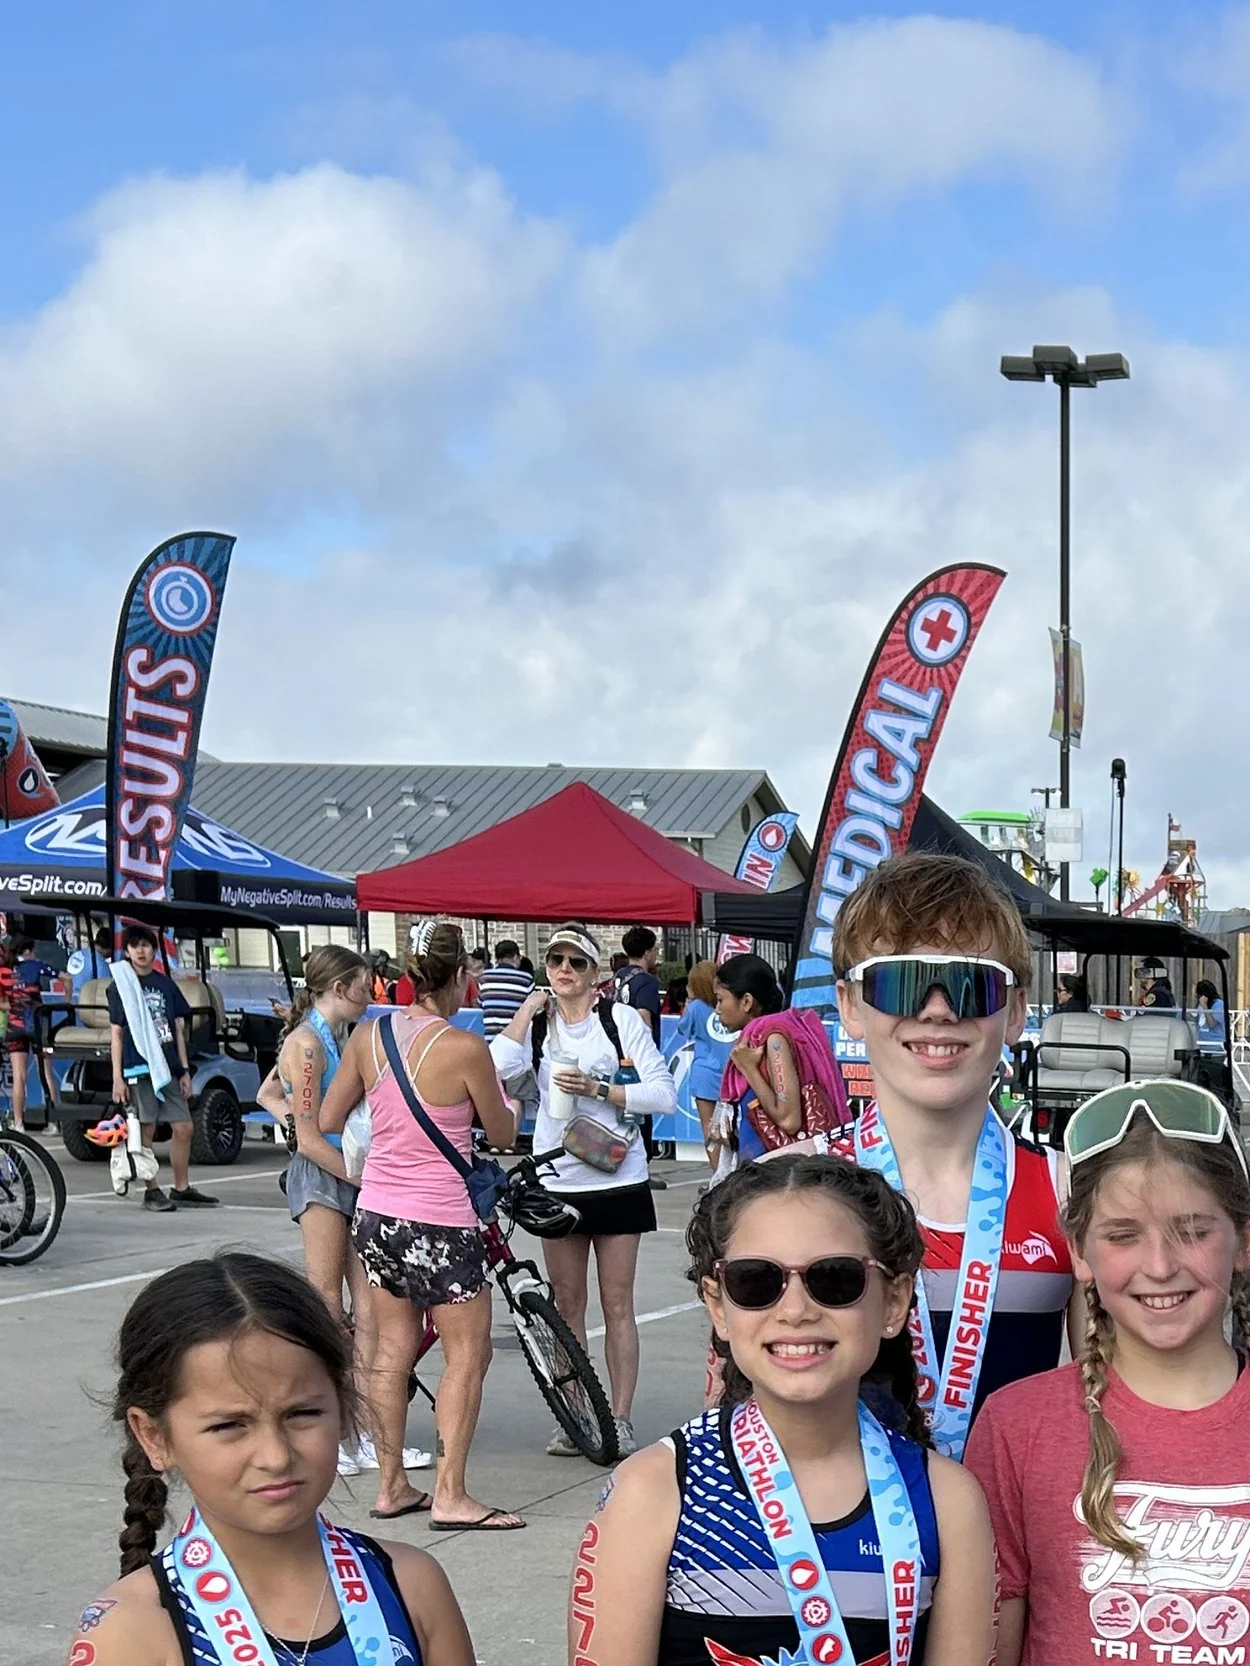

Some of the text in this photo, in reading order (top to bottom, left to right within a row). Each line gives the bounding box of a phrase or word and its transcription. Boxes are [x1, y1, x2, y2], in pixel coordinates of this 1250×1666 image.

[944, 1259, 994, 1410] FINISHER
[1091, 1638, 1247, 1666] TRI TEAM
